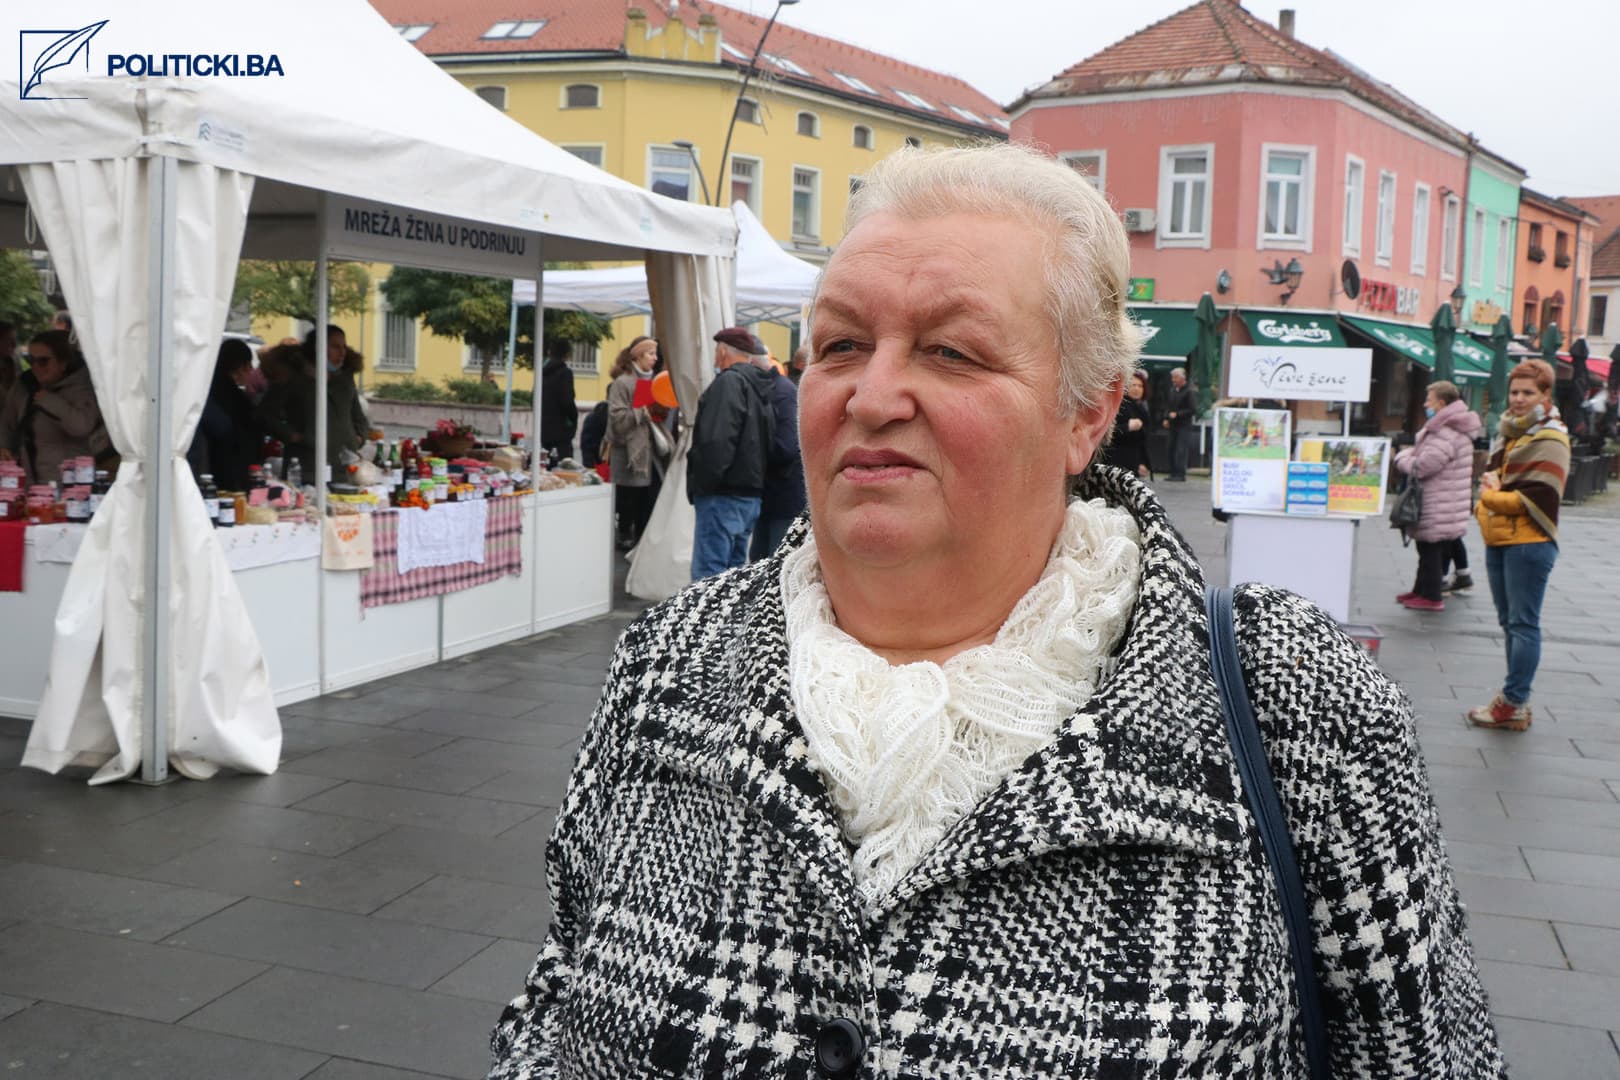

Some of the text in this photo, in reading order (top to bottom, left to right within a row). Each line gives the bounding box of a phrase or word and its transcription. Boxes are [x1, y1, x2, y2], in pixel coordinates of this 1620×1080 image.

[344, 207, 526, 256] MREŽA ŽENA U PODRINJU
[1397, 287, 1420, 315] BAR
[1257, 319, 1332, 343] Carlsberg
